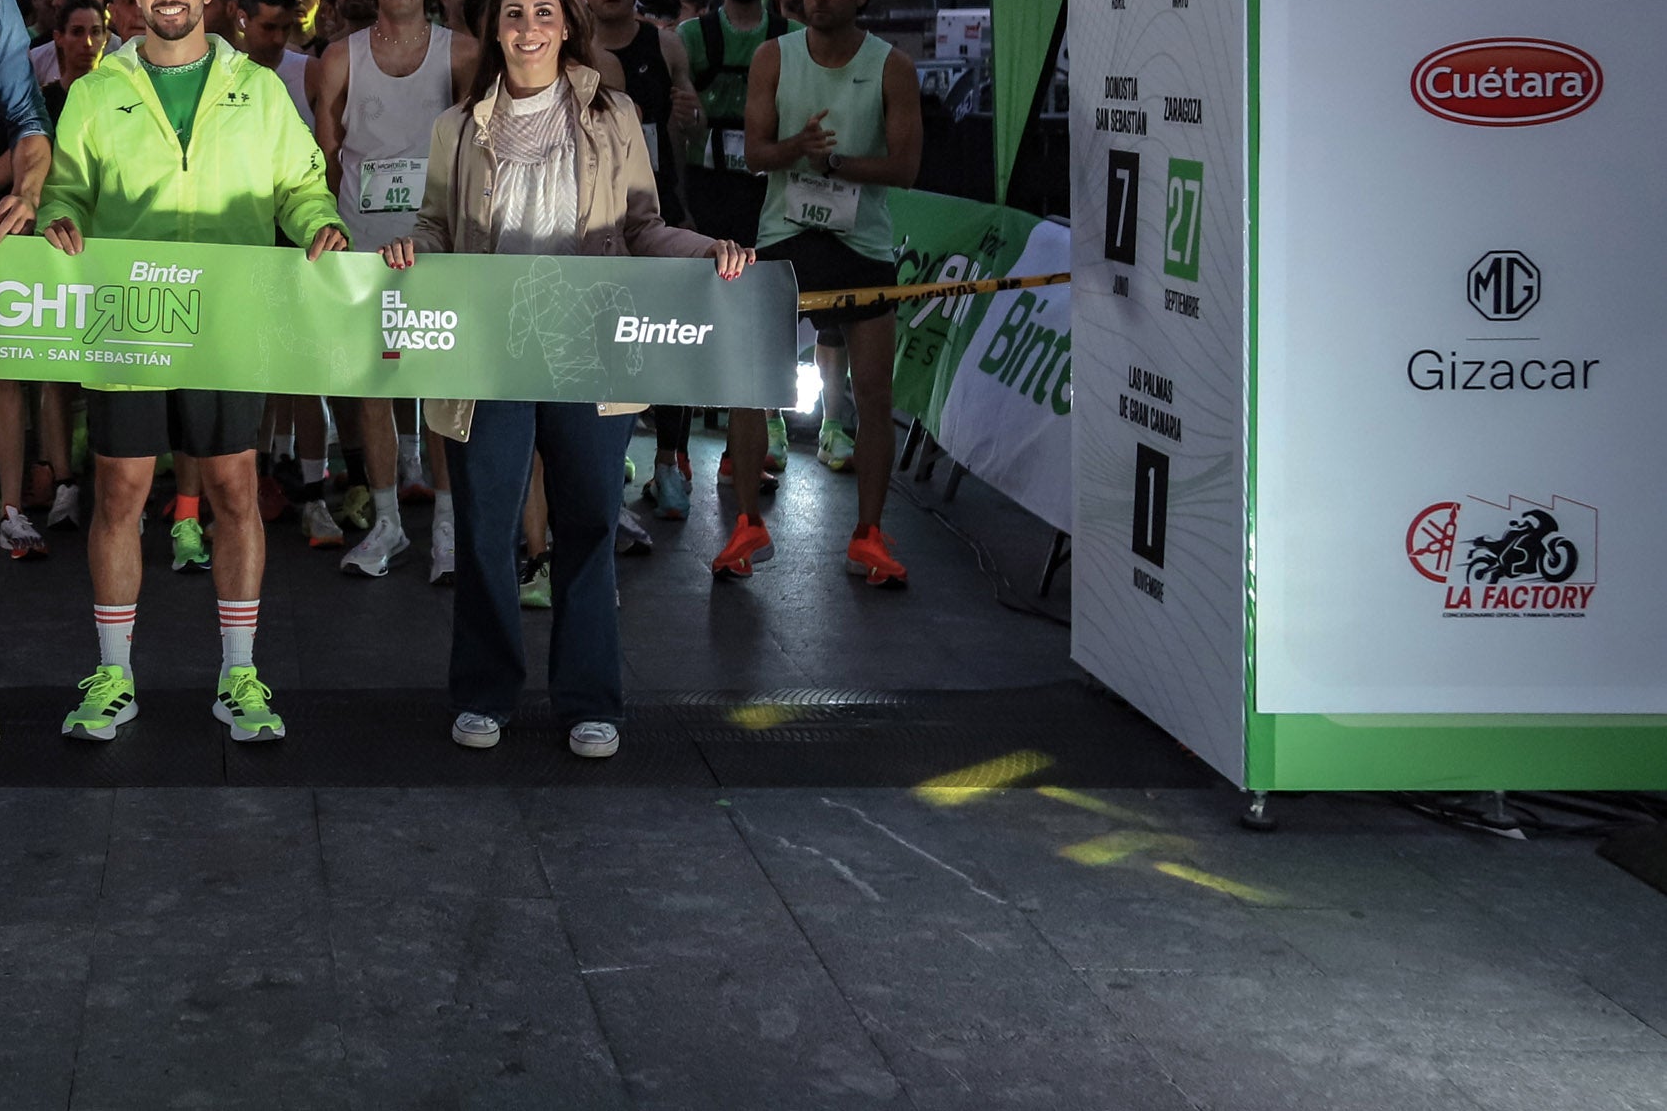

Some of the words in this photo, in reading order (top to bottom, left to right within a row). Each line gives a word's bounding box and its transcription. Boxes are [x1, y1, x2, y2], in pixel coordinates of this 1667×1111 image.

[1105, 75, 1138, 103] DONOSTIA
[1426, 63, 1584, 100] Cuétara
[1096, 107, 1108, 133] SAN
[1111, 104, 1147, 137] SEBASTIÁN
[1164, 96, 1203, 126] ZARAGOZA
[385, 187, 410, 203] 412
[1116, 168, 1130, 250] 7
[801, 203, 832, 223] 1457
[1168, 173, 1200, 271] 27
[130, 260, 203, 285] Binter
[1474, 257, 1534, 315] MG
[382, 290, 406, 309] EL
[1164, 287, 1200, 320] SEPTIEMBRE
[382, 309, 458, 330] DIARIO
[615, 316, 713, 345] Binter
[383, 329, 455, 350] VASCO
[978, 290, 1071, 415] Binte
[48, 348, 79, 363] SAN
[85, 348, 171, 366] SEBASTIÁN
[1407, 350, 1600, 390] Gizacar
[1129, 364, 1142, 394] LAS
[1144, 371, 1173, 405] PALMAS
[1119, 396, 1129, 422] DE
[1130, 399, 1149, 430] GRAN
[1150, 407, 1182, 443] CANARIA
[1147, 467, 1156, 547] 1
[1134, 566, 1165, 604] NOVIEMBRE
[1444, 586, 1472, 609] LA
[1481, 586, 1596, 609] FACTORY
